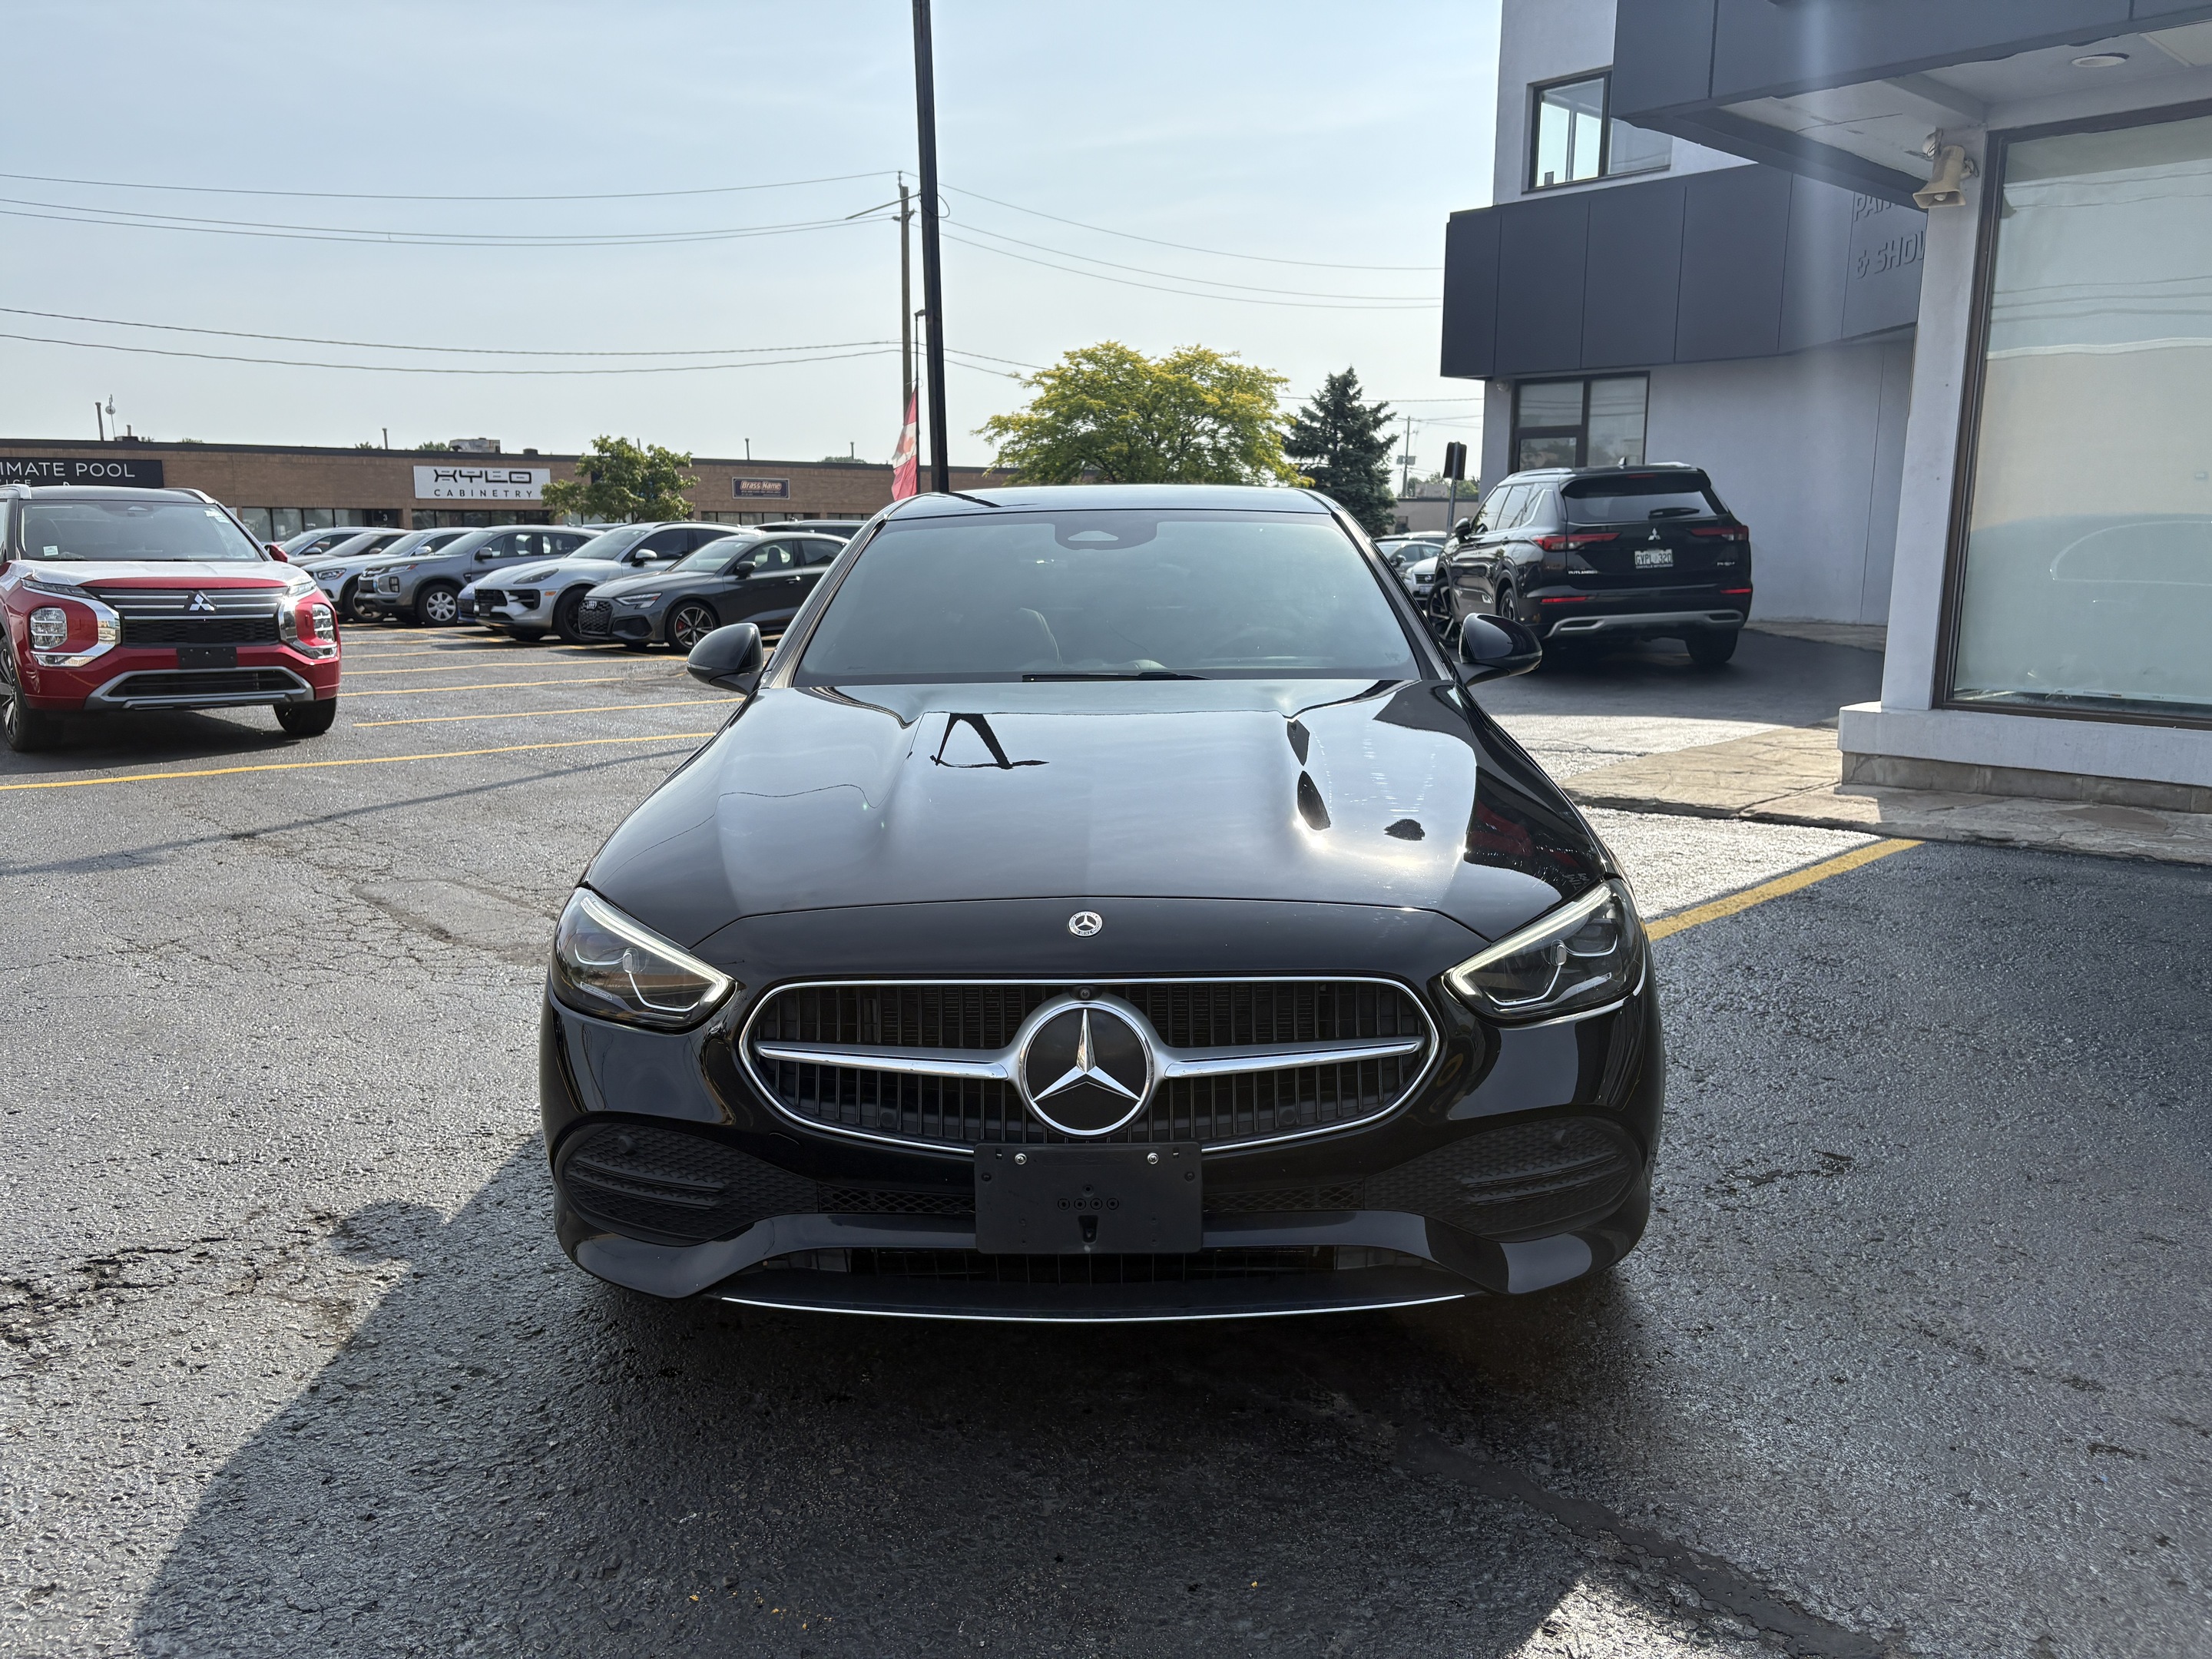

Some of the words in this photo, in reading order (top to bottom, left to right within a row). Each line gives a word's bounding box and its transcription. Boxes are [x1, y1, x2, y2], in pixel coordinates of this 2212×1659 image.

[0, 462, 66, 477] IMATE
[75, 462, 135, 478] POOL
[434, 469, 532, 484] XYLO
[0, 478, 31, 487] ICE
[740, 480, 762, 490] Brass
[434, 488, 532, 498] CABINETRY
